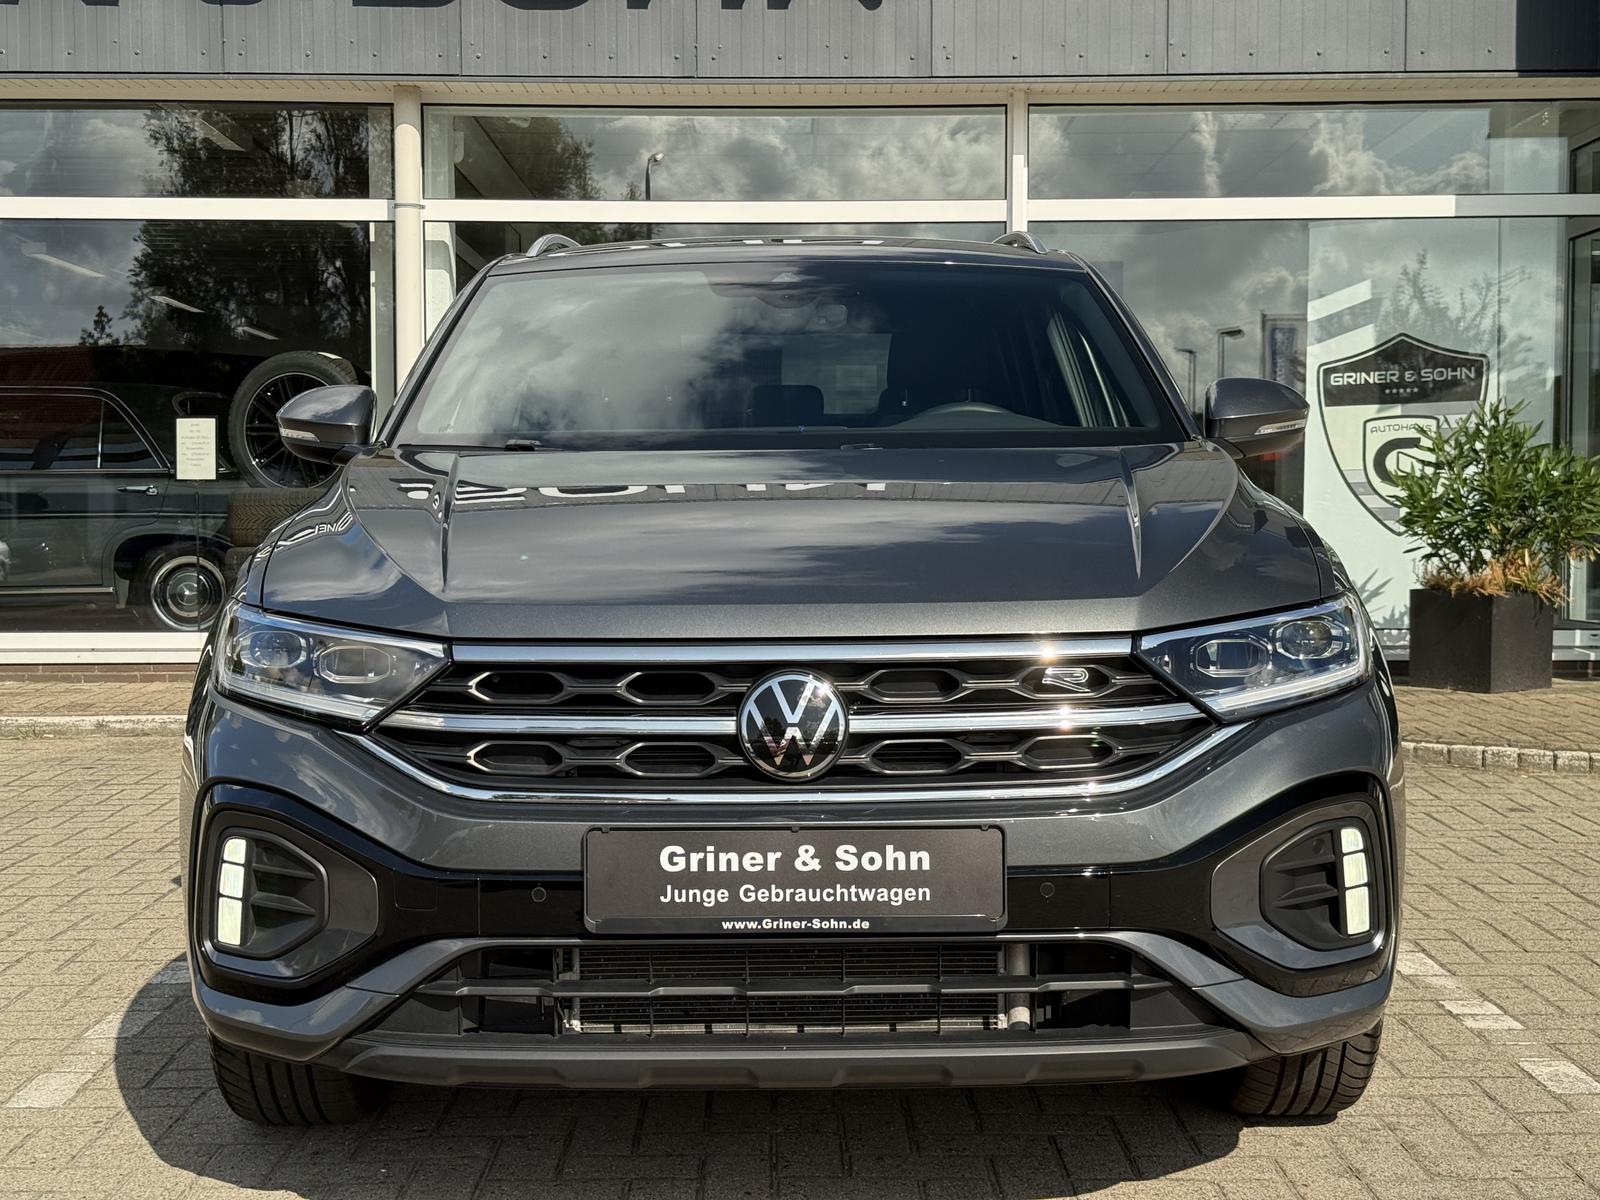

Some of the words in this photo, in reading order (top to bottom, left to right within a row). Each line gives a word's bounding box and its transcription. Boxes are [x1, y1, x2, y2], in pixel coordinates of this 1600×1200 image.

[1330, 370, 1400, 386] GRINER
[1404, 370, 1417, 382] &
[1420, 366, 1476, 382] SOHN
[660, 845, 782, 872] Griner
[794, 844, 822, 872] &
[835, 844, 930, 871] Sohn
[660, 884, 729, 907] Junge
[739, 884, 931, 906] Gebrauchtwagen
[721, 918, 870, 929] www.Griner-Sohn.de
